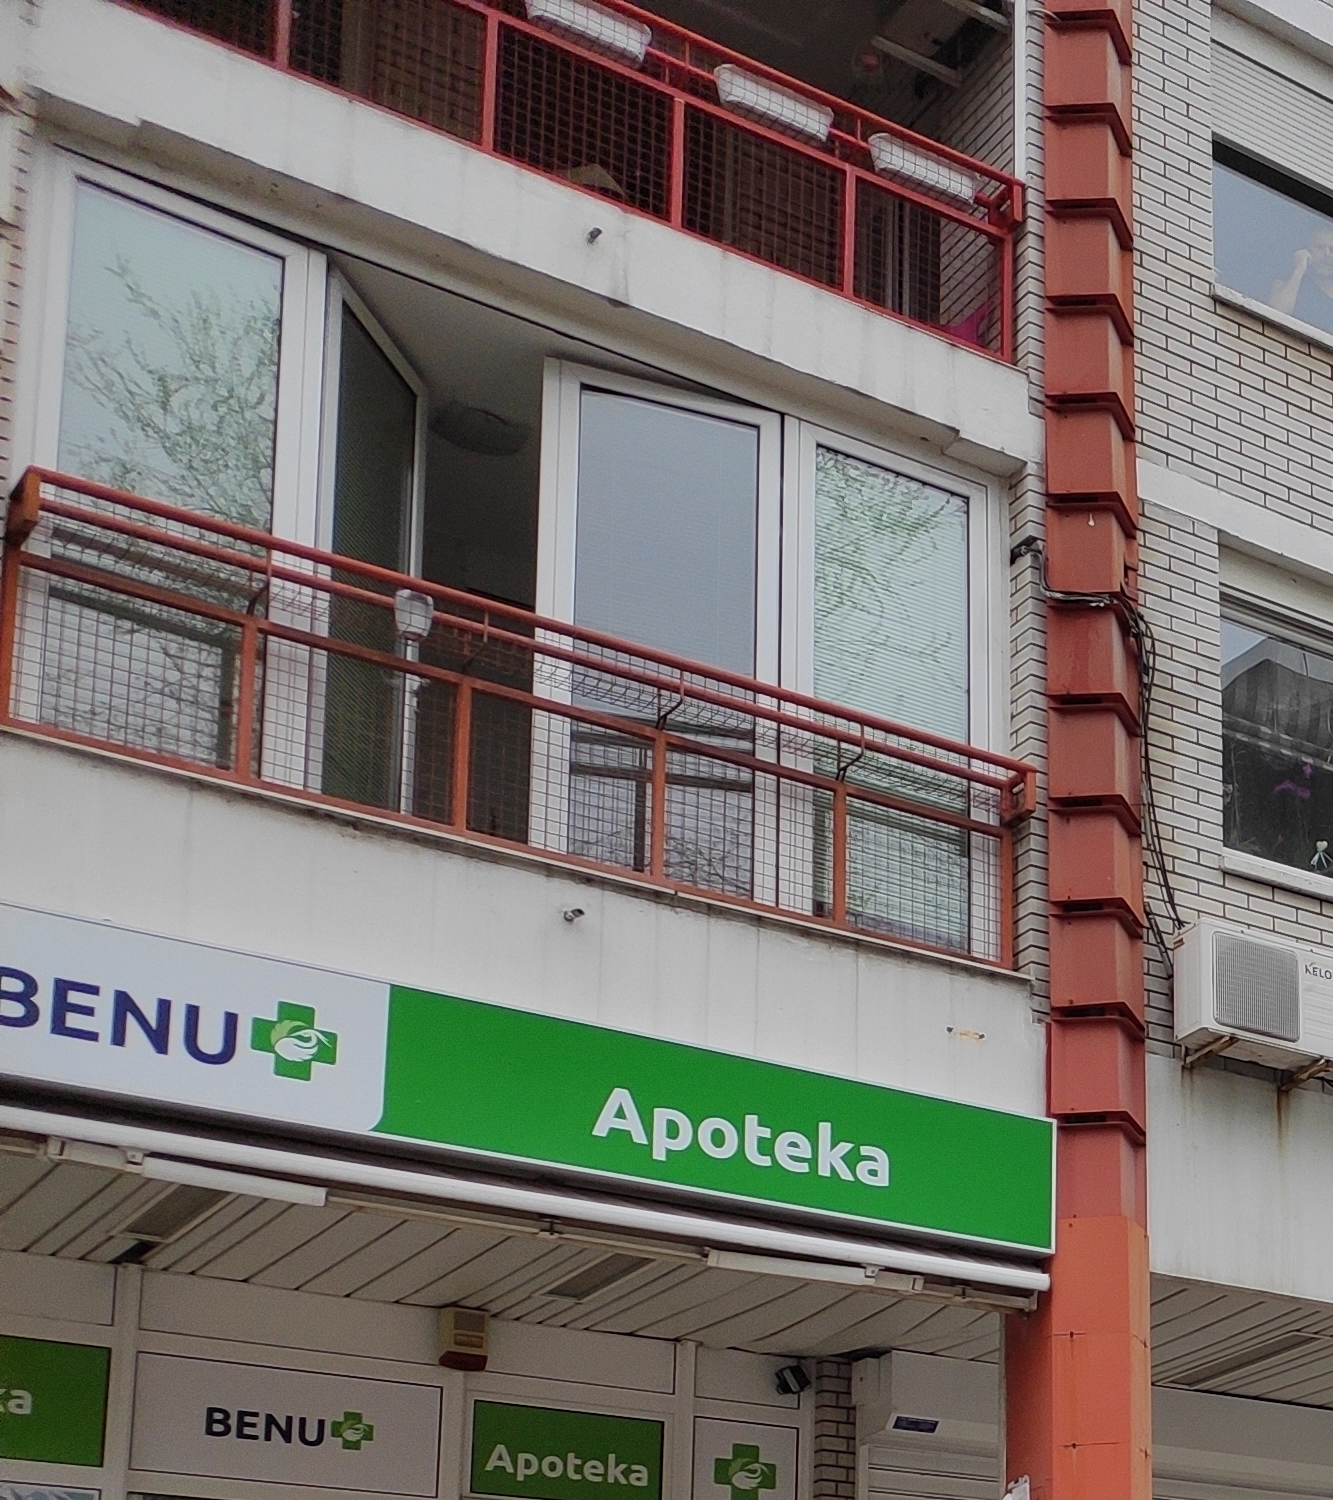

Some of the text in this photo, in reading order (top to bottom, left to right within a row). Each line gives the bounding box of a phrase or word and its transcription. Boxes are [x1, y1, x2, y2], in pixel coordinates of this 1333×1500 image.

[0, 966, 239, 1065] BENU
[591, 1087, 890, 1187] Apoteka
[204, 1406, 326, 1447] BENU
[484, 1443, 649, 1487] Apoteka
